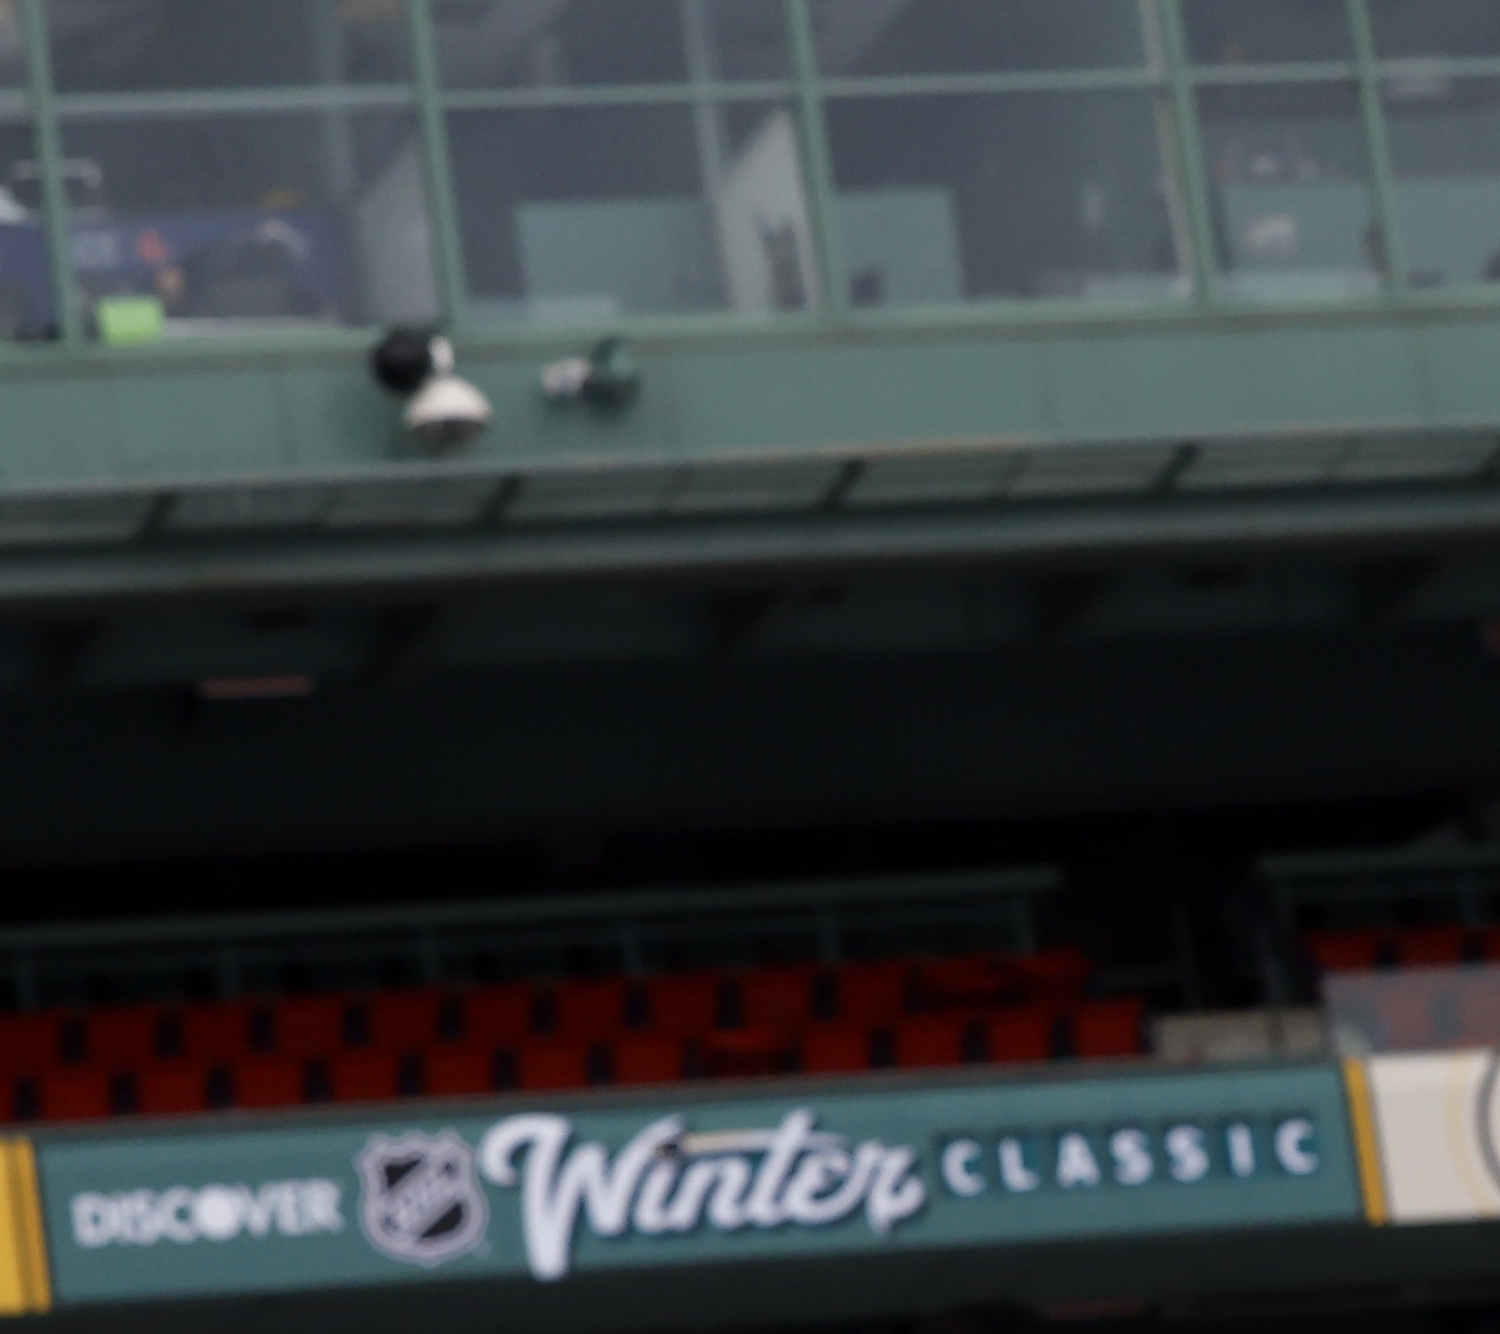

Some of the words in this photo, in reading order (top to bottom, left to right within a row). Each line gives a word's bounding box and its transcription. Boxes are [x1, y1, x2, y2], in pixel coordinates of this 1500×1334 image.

[72, 1179, 345, 1247] DISCOVER
[479, 1108, 927, 1282] Winter
[940, 1117, 1319, 1198] CLASSIC
